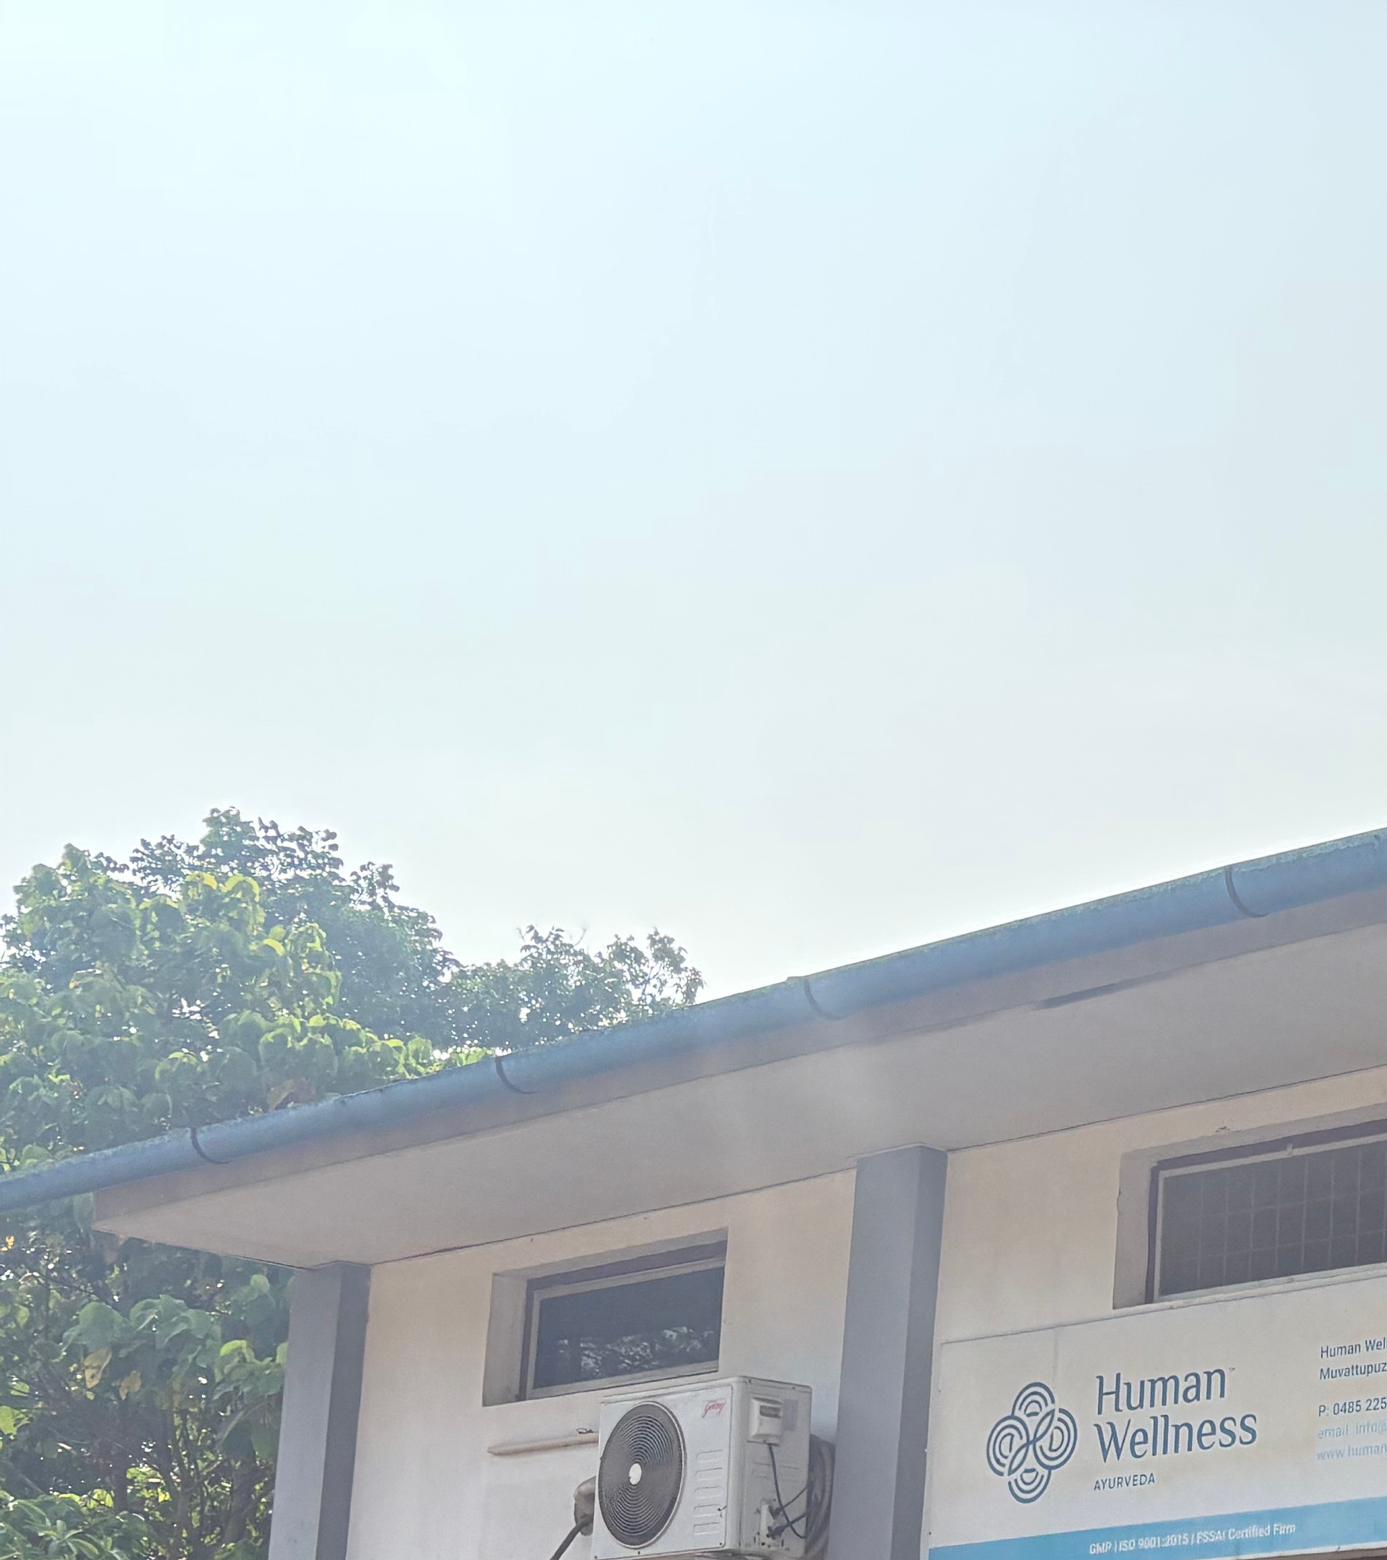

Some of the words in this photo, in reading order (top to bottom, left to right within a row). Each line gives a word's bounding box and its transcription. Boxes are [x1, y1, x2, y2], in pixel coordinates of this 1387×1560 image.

[1320, 1344, 1361, 1359] Human
[1096, 1367, 1227, 1416] Human
[1333, 1400, 1362, 1416] 0485
[1093, 1413, 1258, 1464] Wellness
[1093, 1472, 1156, 1492] AYURVEDA
[1089, 1543, 1112, 1555] GMP
[1118, 1540, 1136, 1551] ISO
[1228, 1524, 1271, 1541] Certified
[1273, 1522, 1296, 1536] Firm
